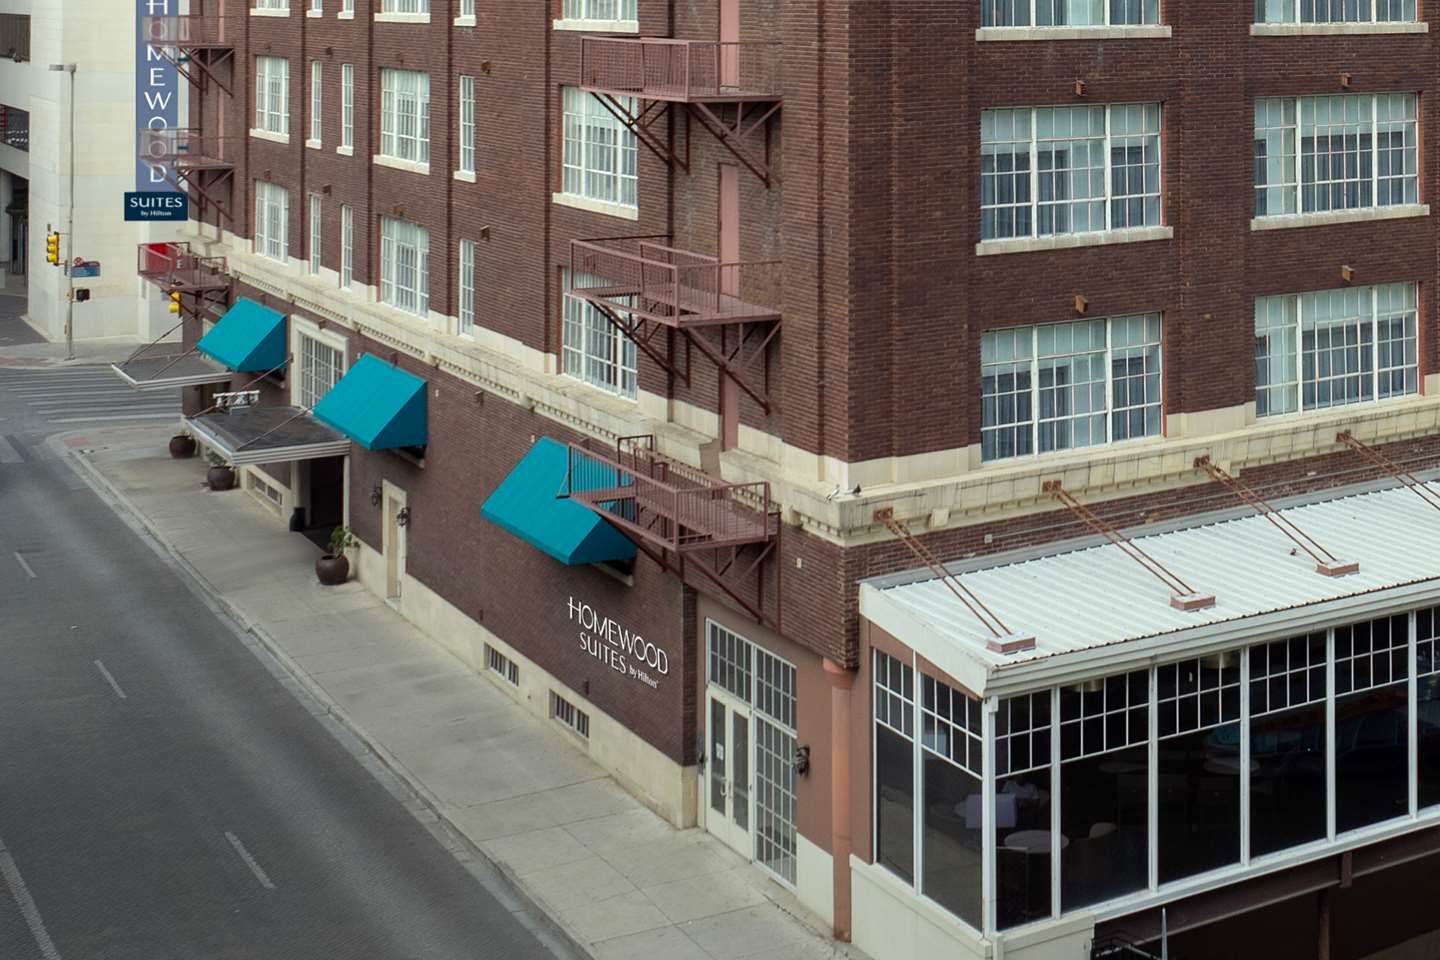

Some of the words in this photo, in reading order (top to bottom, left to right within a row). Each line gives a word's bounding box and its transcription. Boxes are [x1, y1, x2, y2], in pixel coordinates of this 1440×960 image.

[130, 197, 183, 208] SUITES
[140, 210, 149, 218] by
[567, 595, 669, 674] HOMEWOOD
[579, 631, 627, 674] SUITES
[629, 664, 638, 679] by
[637, 669, 659, 689] Hilton
